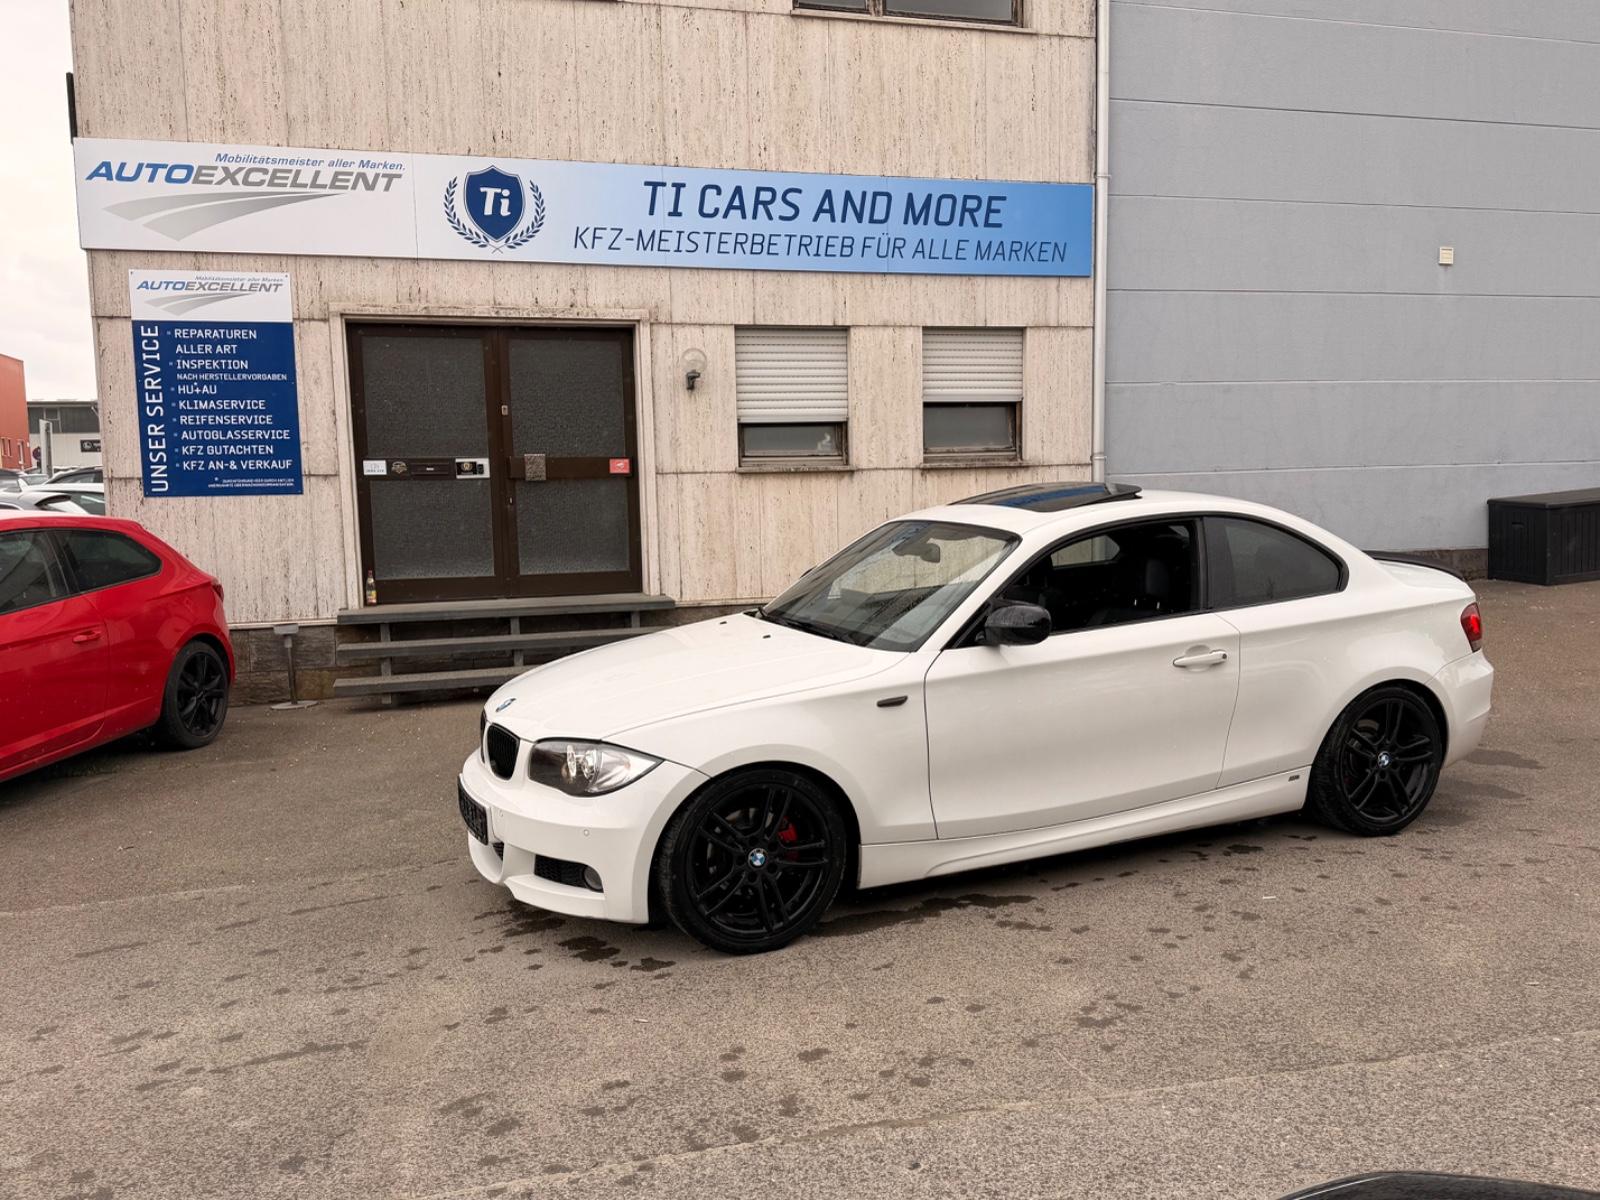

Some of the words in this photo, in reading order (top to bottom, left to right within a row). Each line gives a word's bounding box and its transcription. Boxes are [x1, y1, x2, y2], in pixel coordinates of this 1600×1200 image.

[327, 158, 355, 169] aller
[85, 160, 403, 192] AUTOEXCELLENT
[479, 186, 512, 217] Ti
[643, 181, 687, 217] TI
[697, 184, 803, 222] CARS
[812, 189, 893, 225] AND
[902, 192, 1007, 228] MORE
[573, 226, 855, 258] KFZ-MEISTERBETRIEB
[861, 232, 906, 259] FÜR
[911, 238, 970, 261] ALLE
[974, 240, 1067, 262] MARKEN
[136, 280, 284, 293] AUTOEXCELLENT
[174, 328, 257, 340] REPARATUREN
[175, 344, 212, 354] ALLER
[215, 344, 238, 354] ART
[176, 359, 249, 370] INSPEKTION
[140, 325, 164, 417] SERVICE
[176, 373, 198, 381] NACH
[178, 399, 266, 410] KLIMASERVICE
[180, 414, 273, 425] REIFENSERVICE
[181, 429, 291, 440] AUTOGLASSERVICE
[181, 445, 204, 455] KFZ
[206, 444, 274, 455] GUTACHTEN
[147, 424, 169, 492] UNSER
[182, 460, 205, 471] KFZ
[240, 459, 294, 470] VERKAUF
